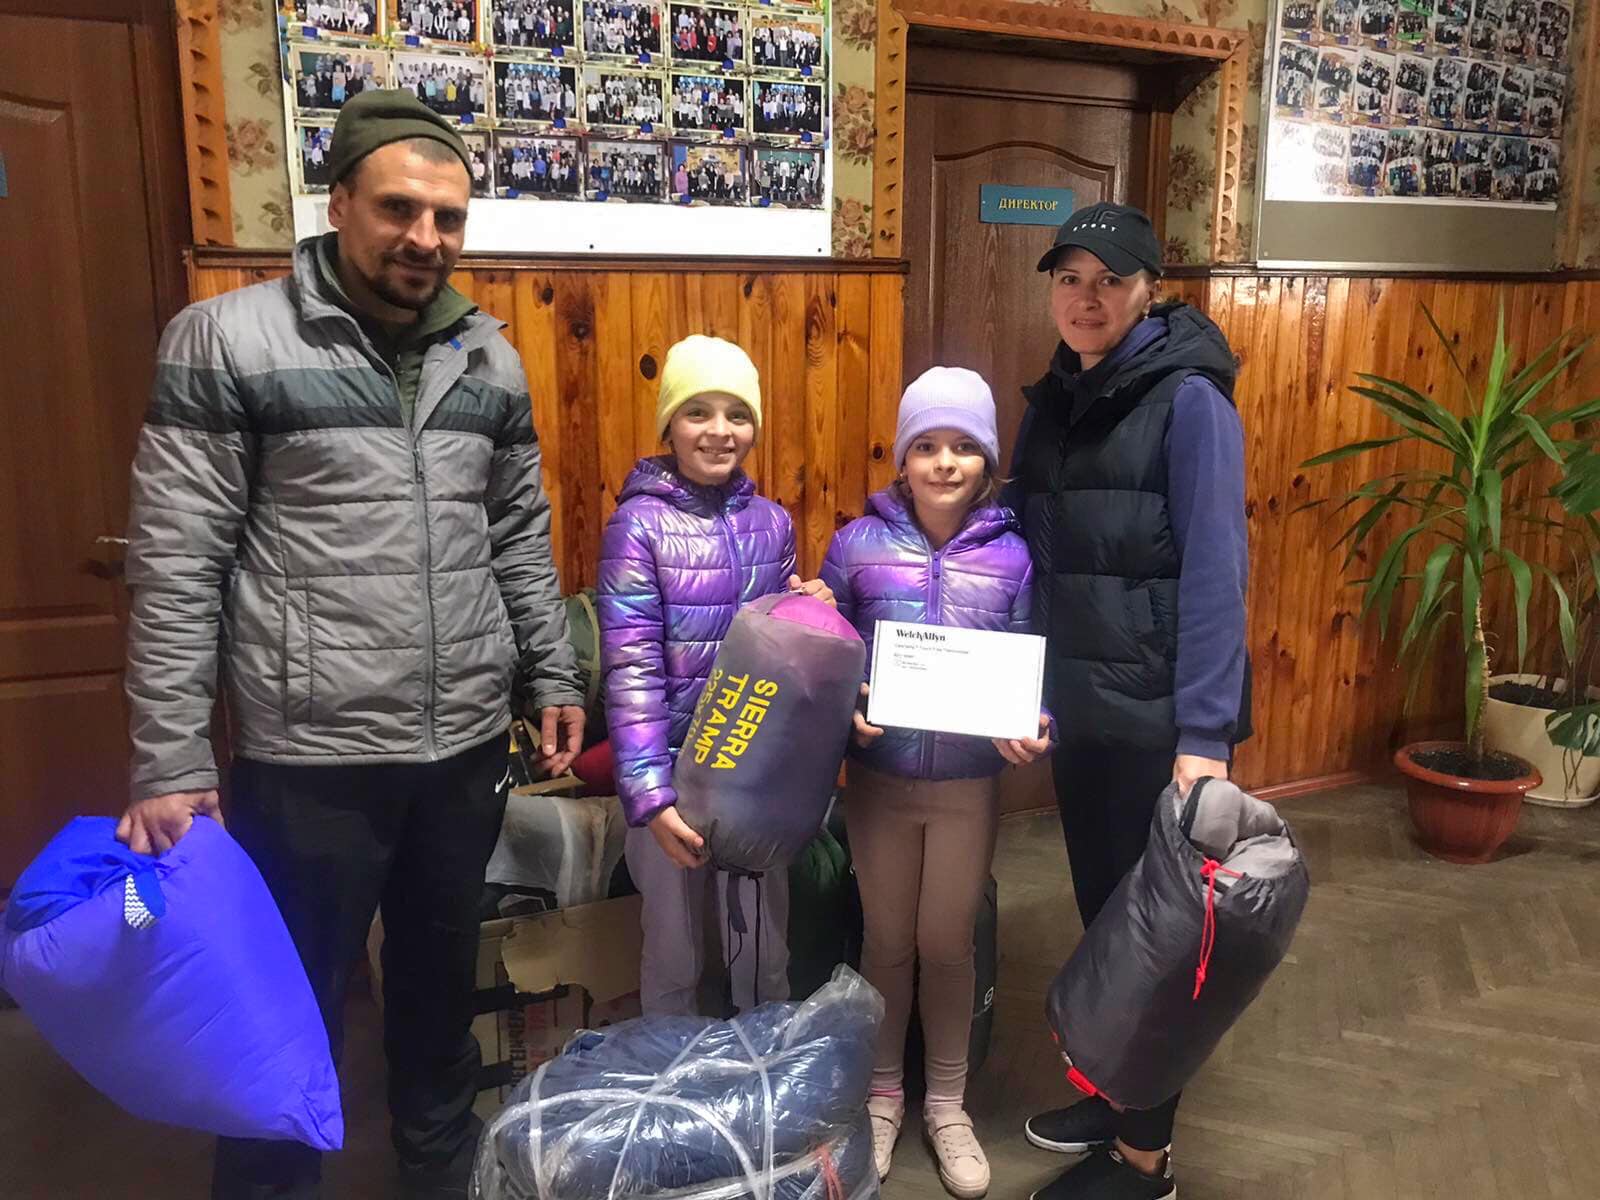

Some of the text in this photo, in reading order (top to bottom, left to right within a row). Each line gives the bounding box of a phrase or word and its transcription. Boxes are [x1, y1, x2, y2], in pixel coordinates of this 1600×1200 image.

[999, 198, 1059, 211] ДИРЕКТОР
[693, 673, 750, 765] TRAMP
[710, 679, 779, 769] SIERRA
